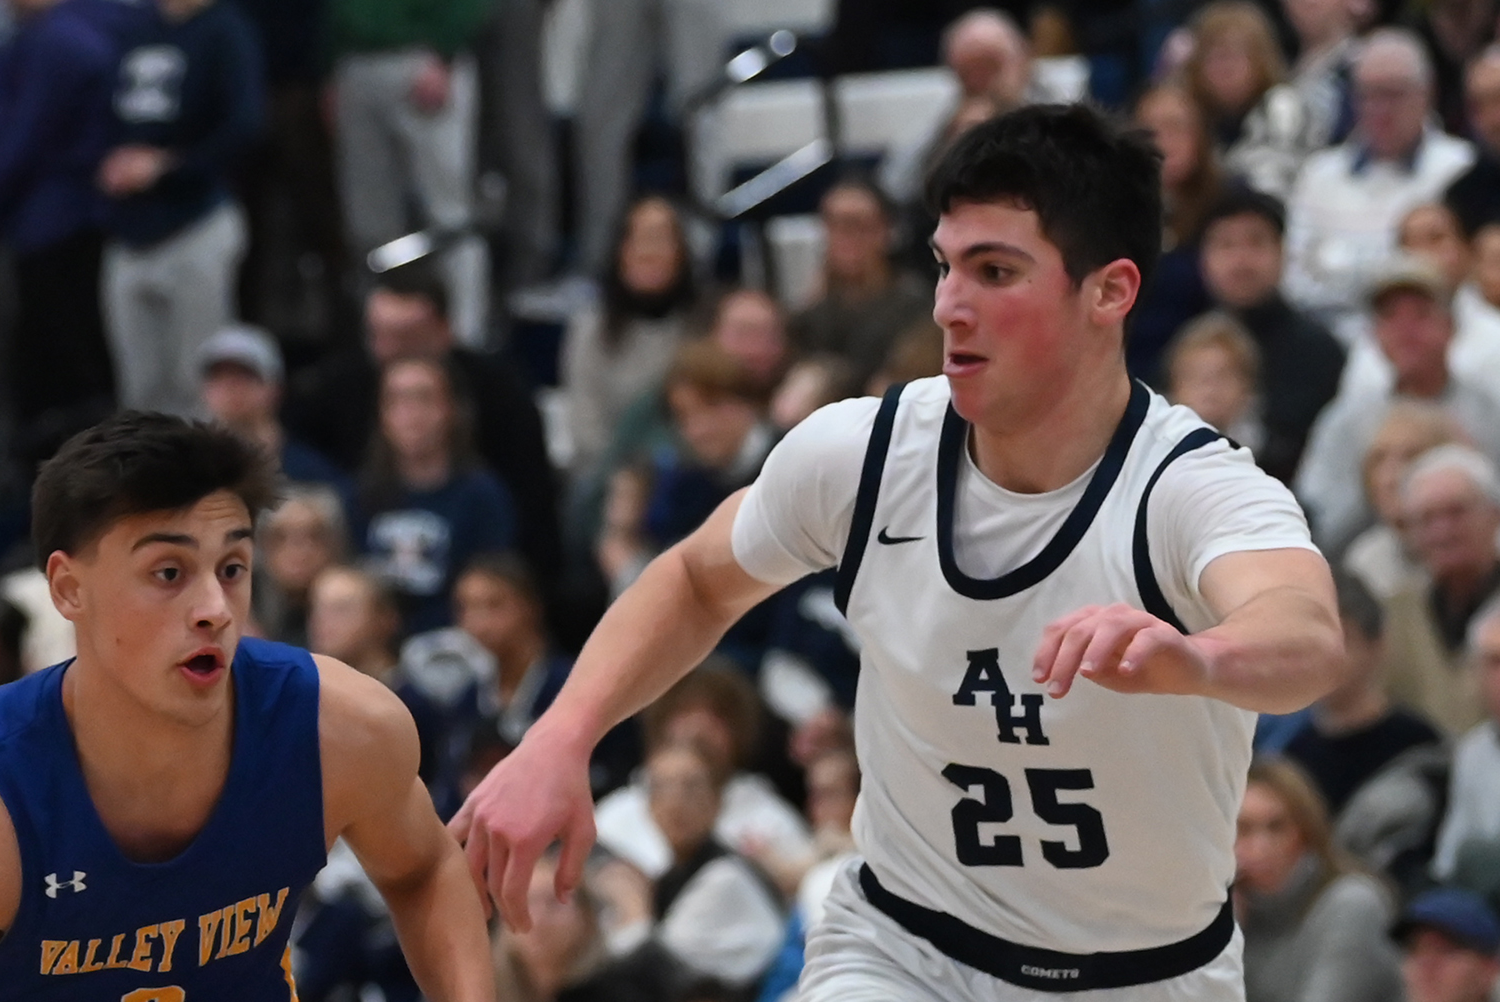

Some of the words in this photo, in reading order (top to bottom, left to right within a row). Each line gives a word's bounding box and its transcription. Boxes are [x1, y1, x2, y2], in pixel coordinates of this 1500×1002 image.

[941, 762, 1110, 869] 25
[40, 918, 186, 975] VALLEY
[198, 886, 290, 967] VIEW
[1020, 964, 1080, 979] COMETS
